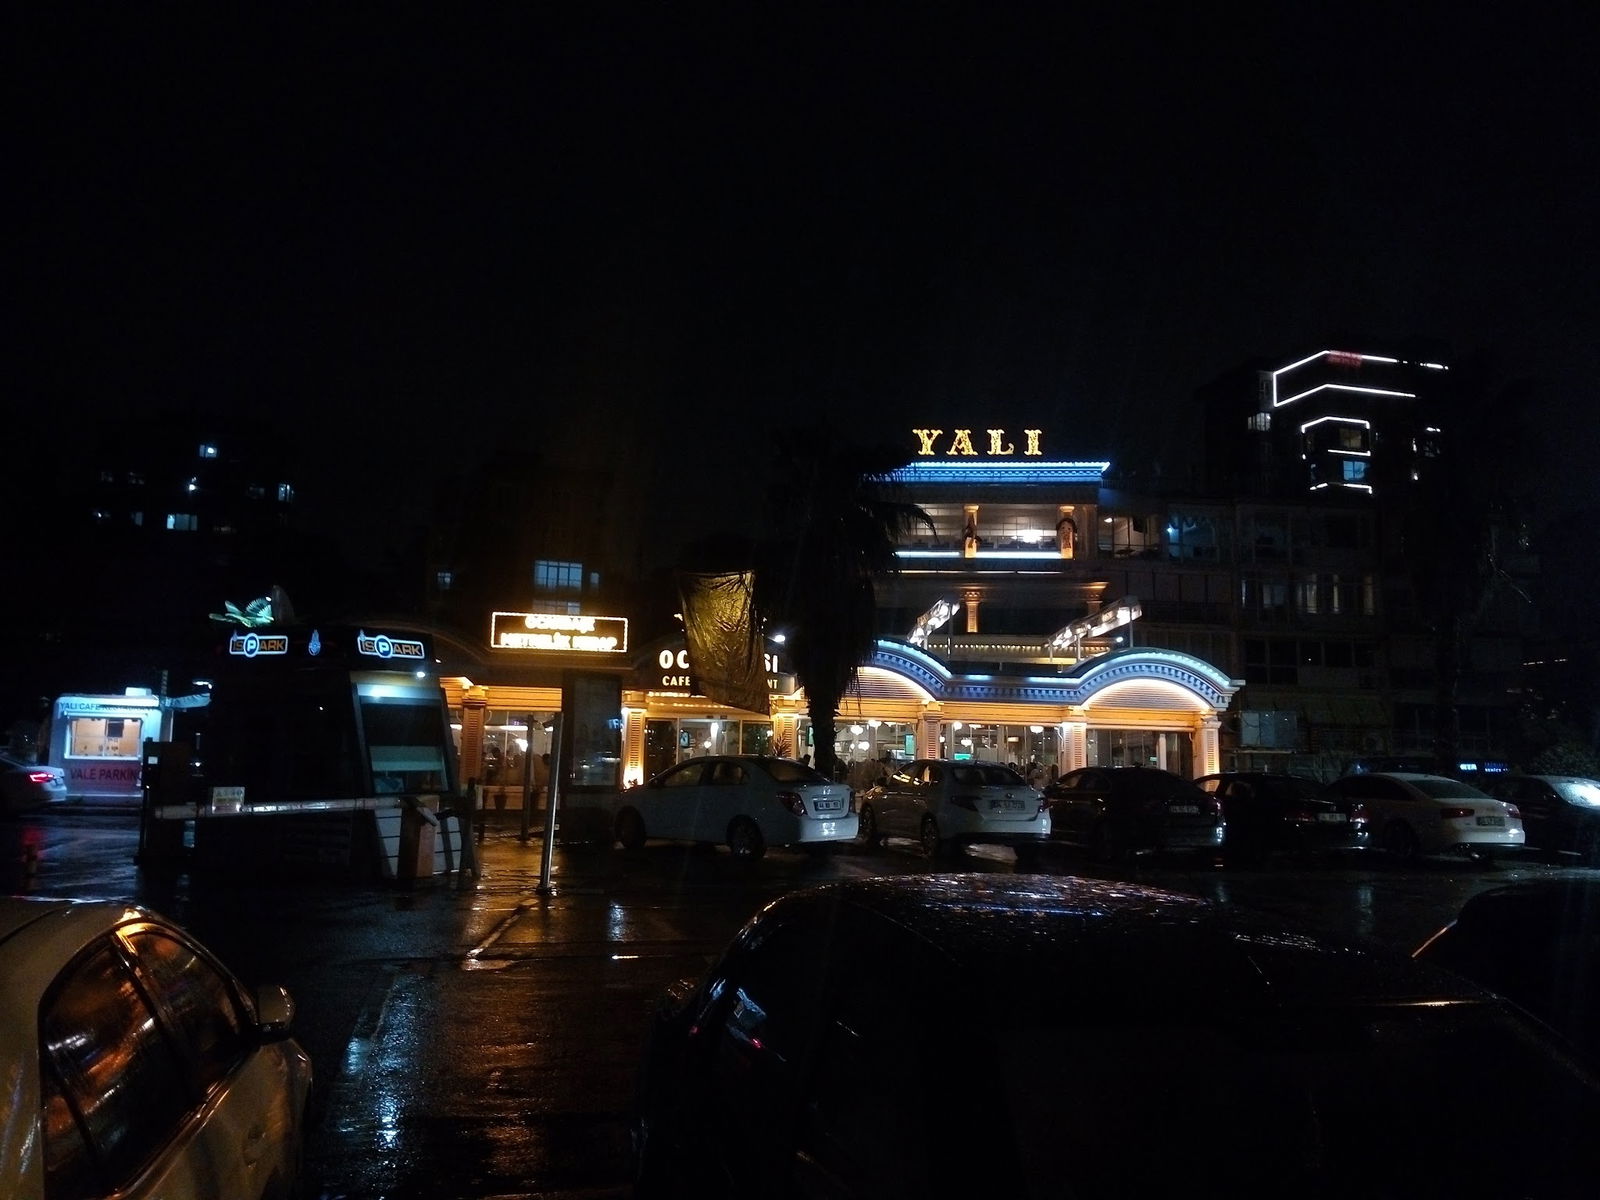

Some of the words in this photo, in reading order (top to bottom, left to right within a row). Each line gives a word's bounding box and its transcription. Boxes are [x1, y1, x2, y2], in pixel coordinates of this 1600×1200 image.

[912, 428, 1043, 456] YALI
[662, 675, 692, 687] CAFE
[70, 768, 96, 780] VALE
